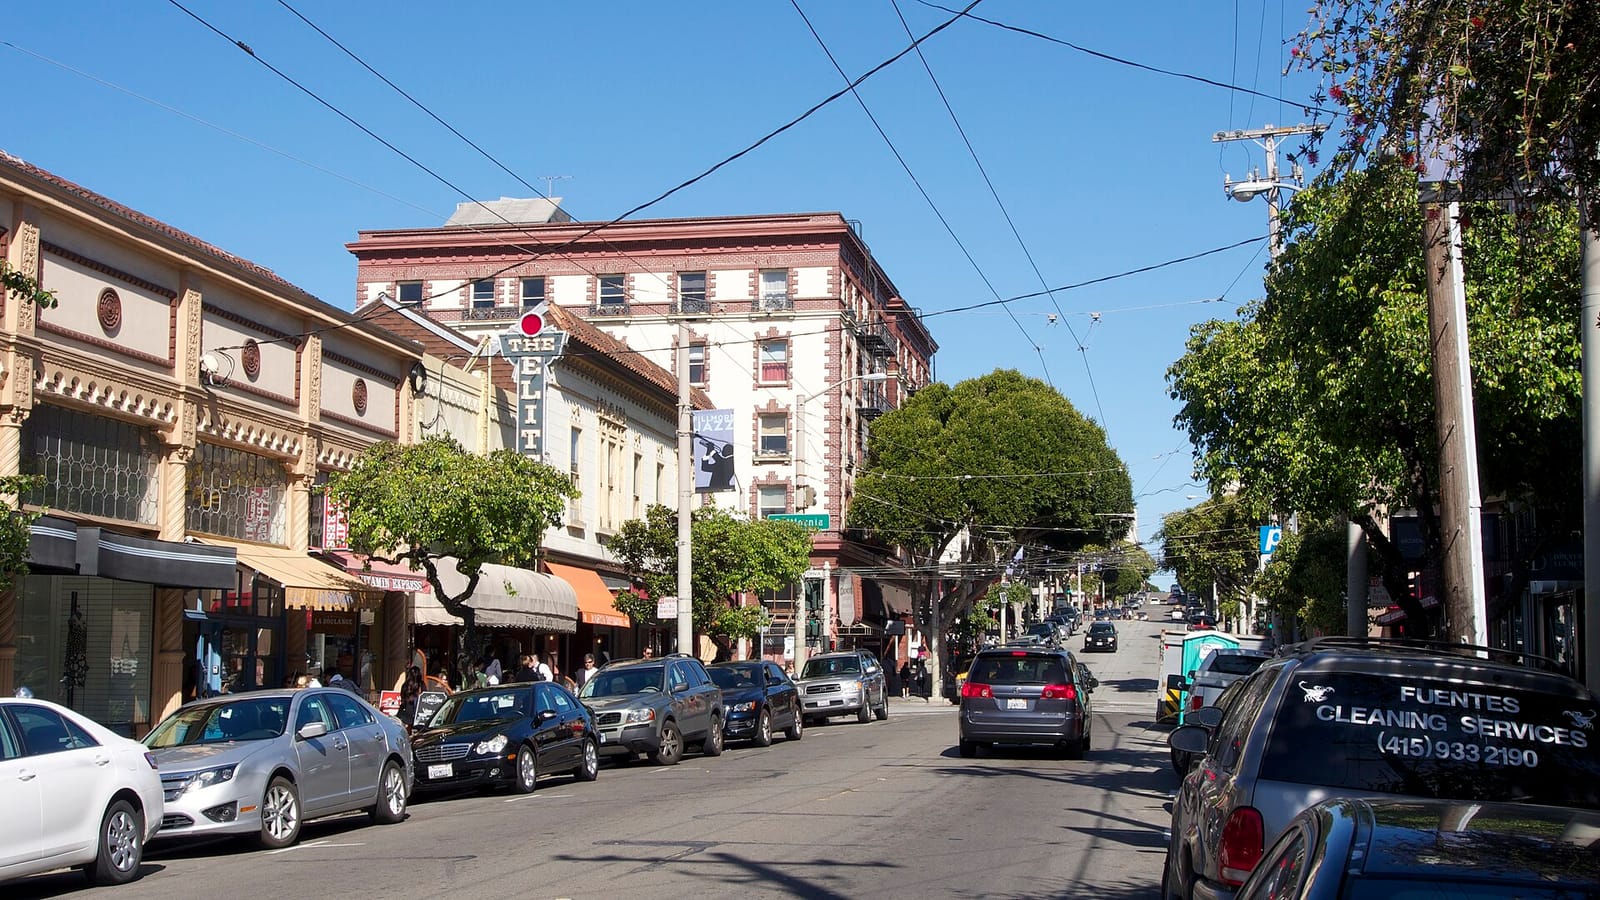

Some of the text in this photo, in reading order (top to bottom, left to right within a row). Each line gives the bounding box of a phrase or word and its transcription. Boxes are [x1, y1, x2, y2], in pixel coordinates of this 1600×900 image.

[509, 338, 555, 352] THE
[392, 577, 423, 592] EXPRESS
[1400, 686, 1521, 714] FUENTES
[1316, 704, 1589, 748] CLEANING SERVICES
[1484, 746, 1539, 768] 2190
